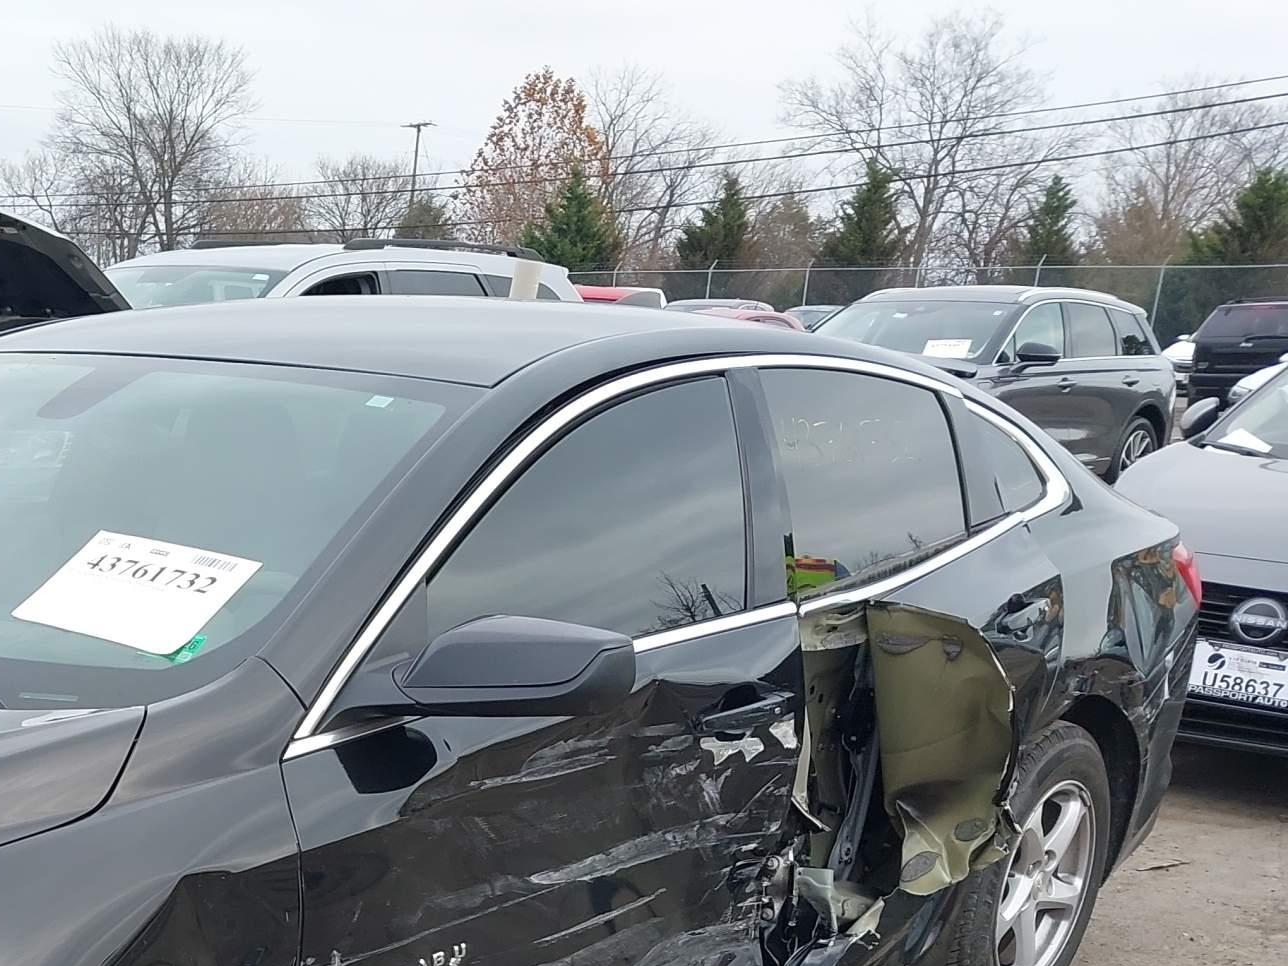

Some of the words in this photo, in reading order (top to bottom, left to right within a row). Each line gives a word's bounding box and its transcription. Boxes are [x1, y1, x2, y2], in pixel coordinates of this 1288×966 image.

[87, 554, 218, 594] 43761732
[1233, 613, 1288, 628] NISSAN
[1202, 671, 1285, 698] U58637
